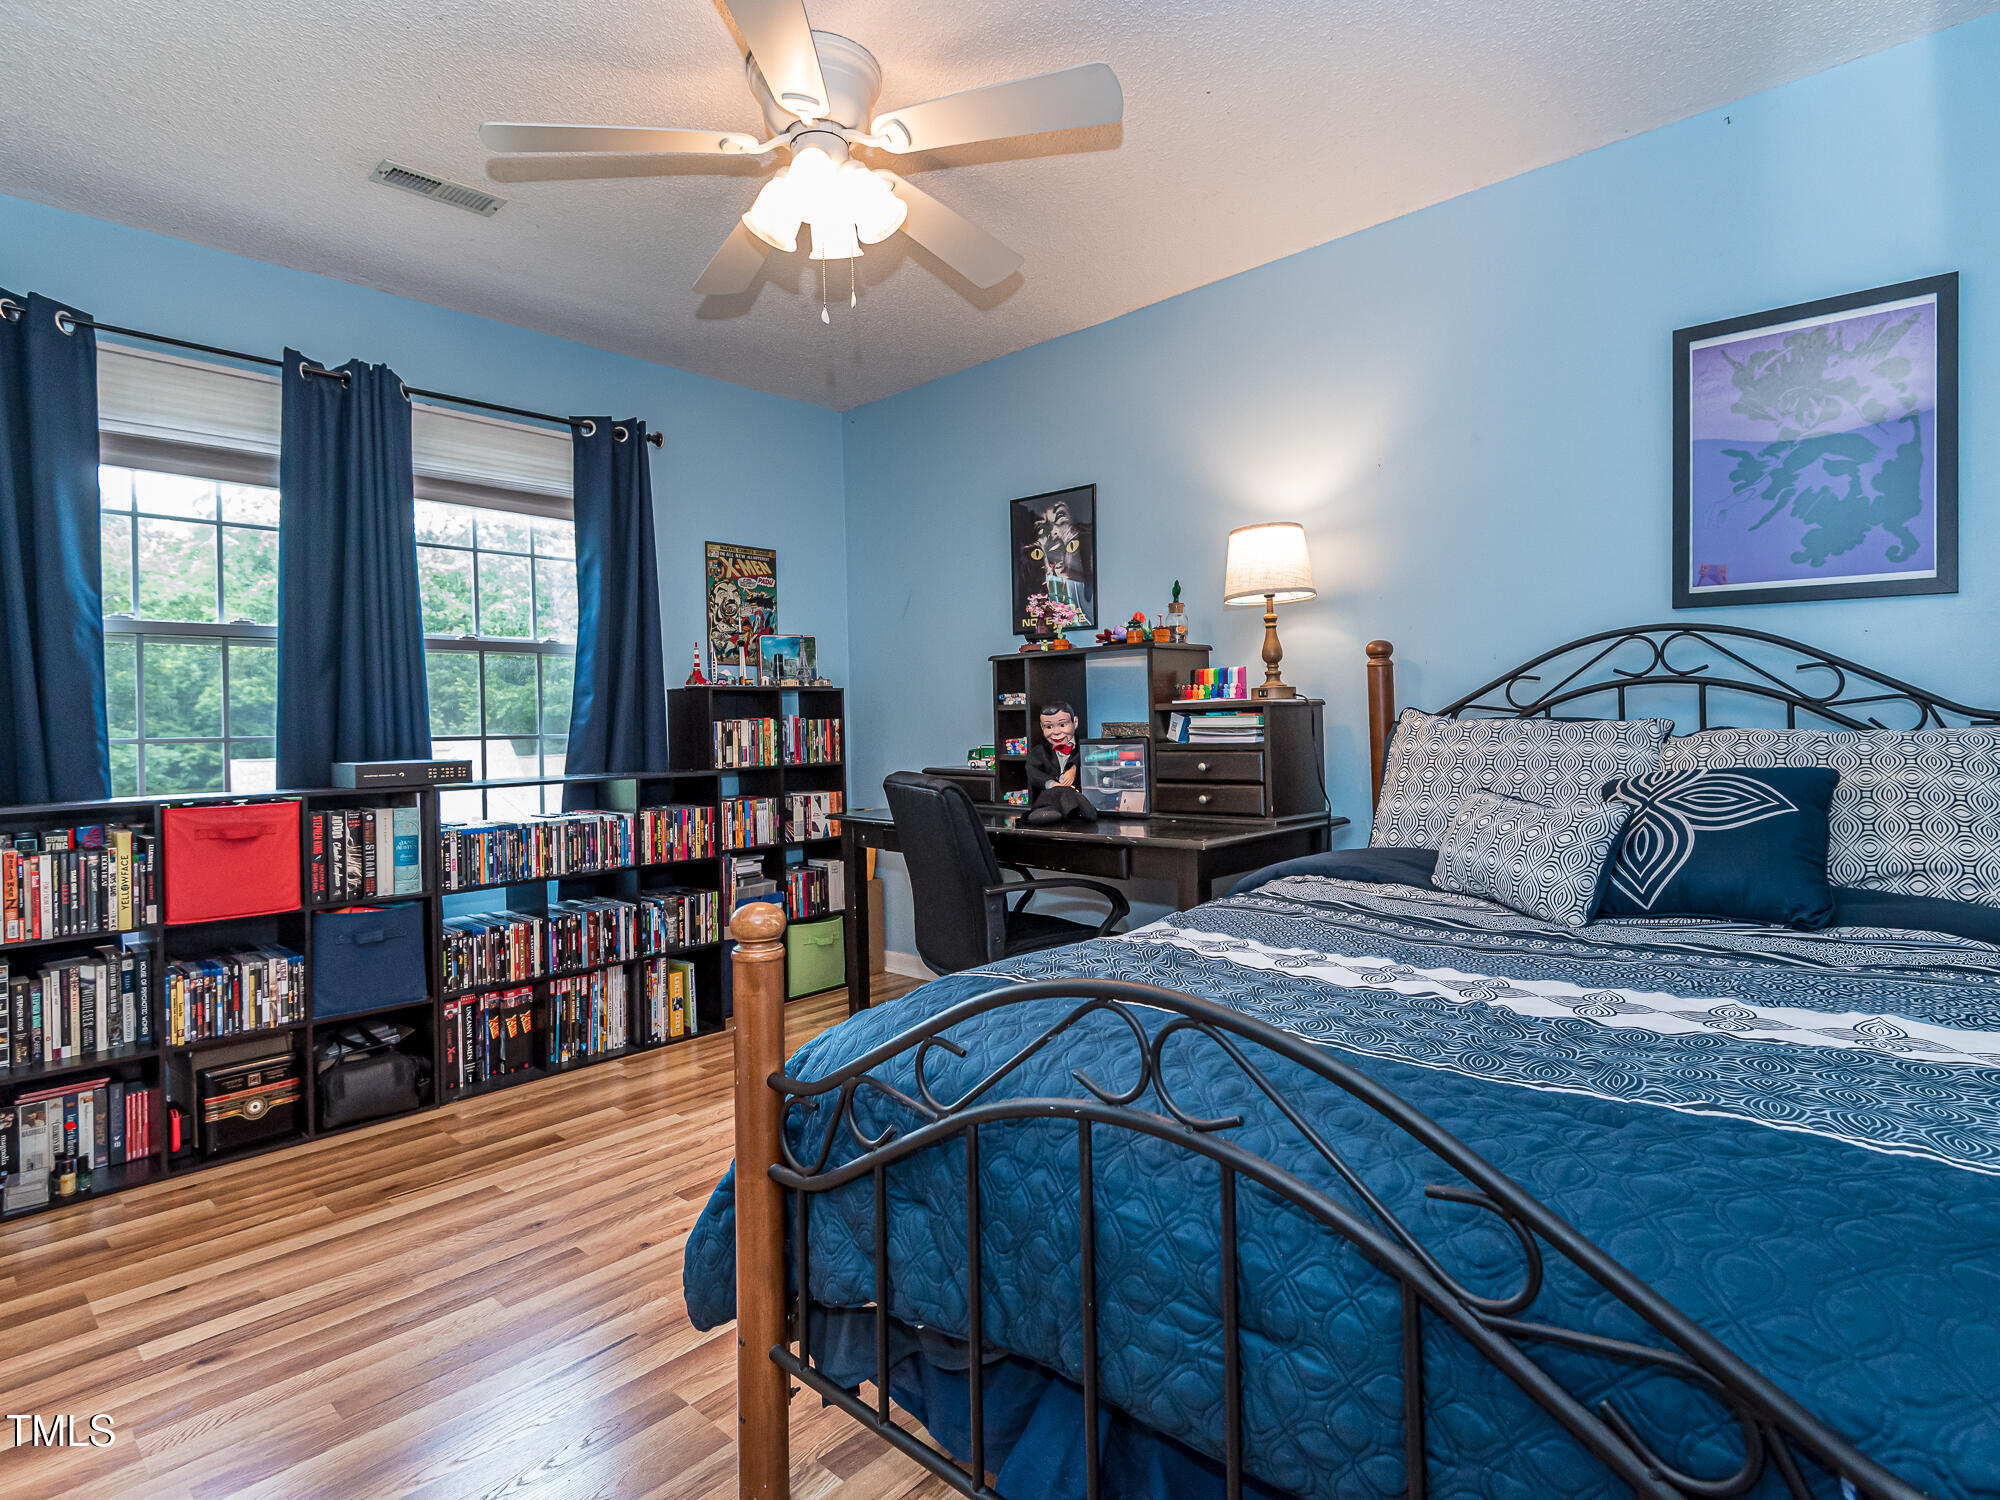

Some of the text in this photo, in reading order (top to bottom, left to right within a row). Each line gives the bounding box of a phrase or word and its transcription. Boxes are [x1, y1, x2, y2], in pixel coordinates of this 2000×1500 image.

[719, 557, 773, 579] X-MEN
[313, 816, 323, 854] STEPHEN KING
[365, 844, 375, 877] STRAIN
[121, 855, 129, 911] YELLOWFACE
[141, 978, 147, 986] OF
[16, 995, 24, 1017] STEPHEN
[82, 989, 94, 1027] MIDDLESEX
[1, 1135, 10, 1166] magnolia
